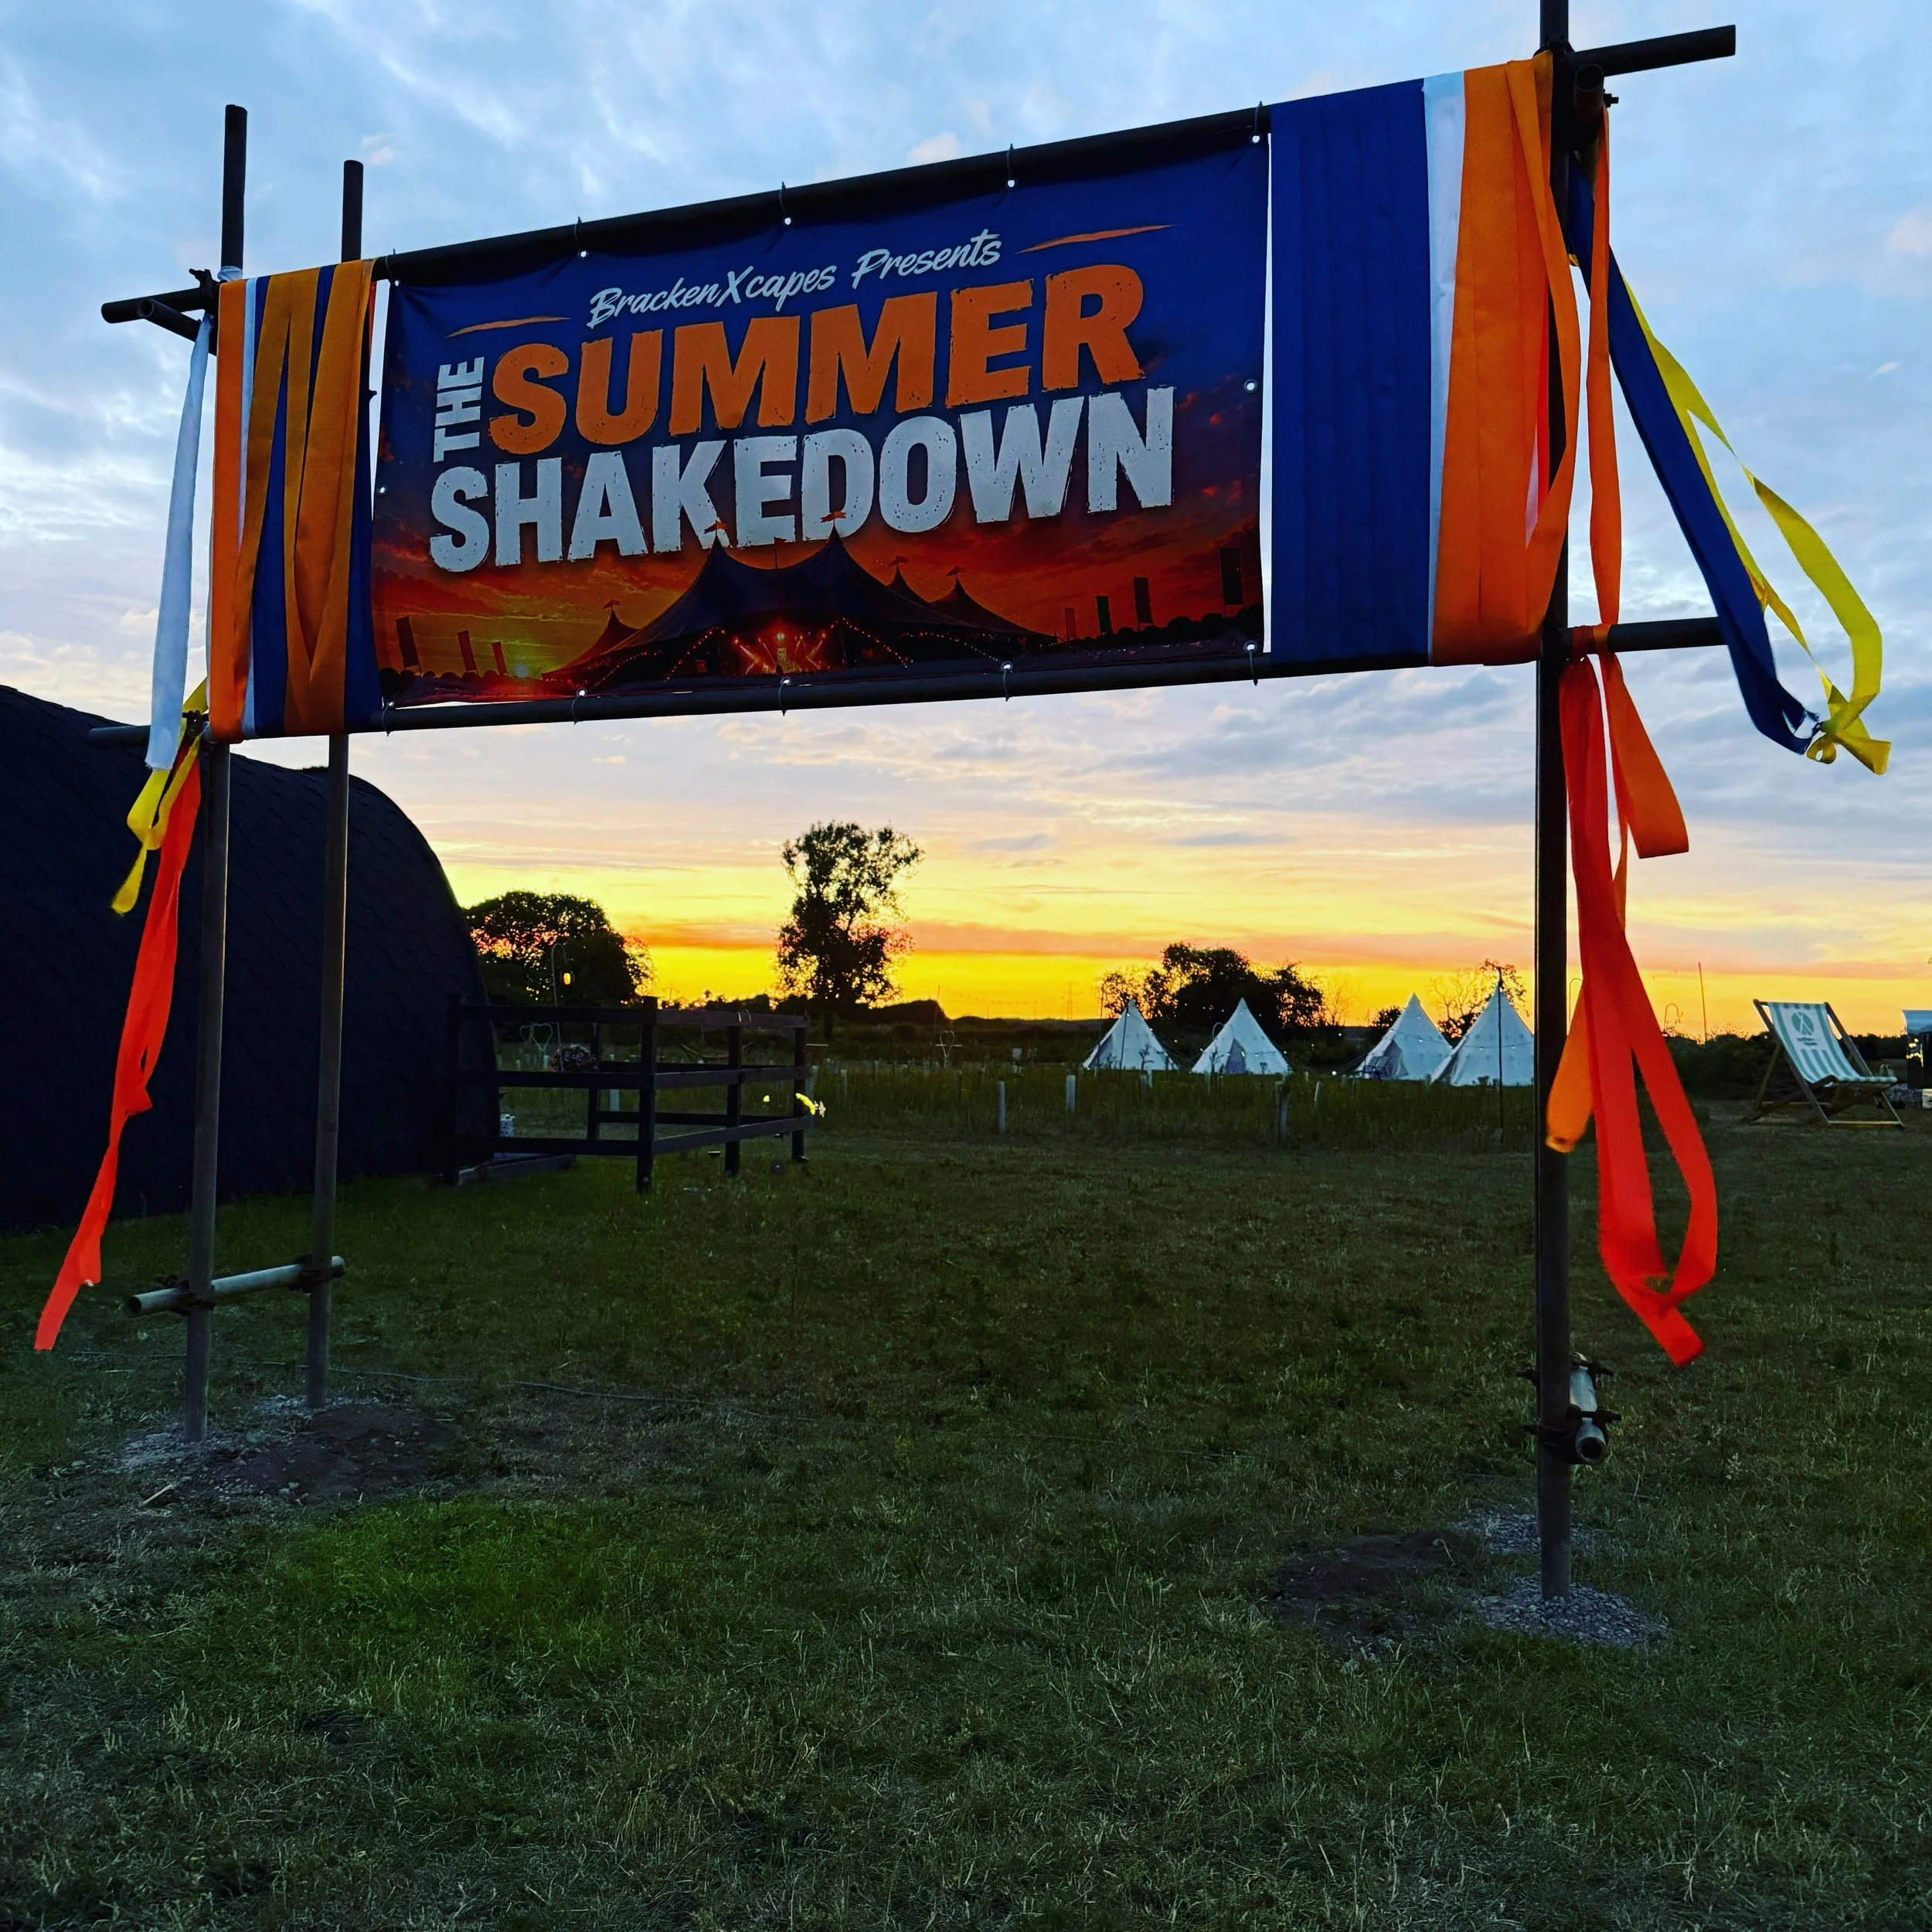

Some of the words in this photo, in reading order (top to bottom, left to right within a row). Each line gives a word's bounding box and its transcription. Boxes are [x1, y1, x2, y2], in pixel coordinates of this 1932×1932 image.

[587, 264, 837, 329] BrackenXcapes
[851, 229, 1002, 289] Presents
[434, 356, 485, 464] THE
[488, 264, 1145, 454] SUMMER
[429, 386, 1175, 573] SHAKEDOWN
